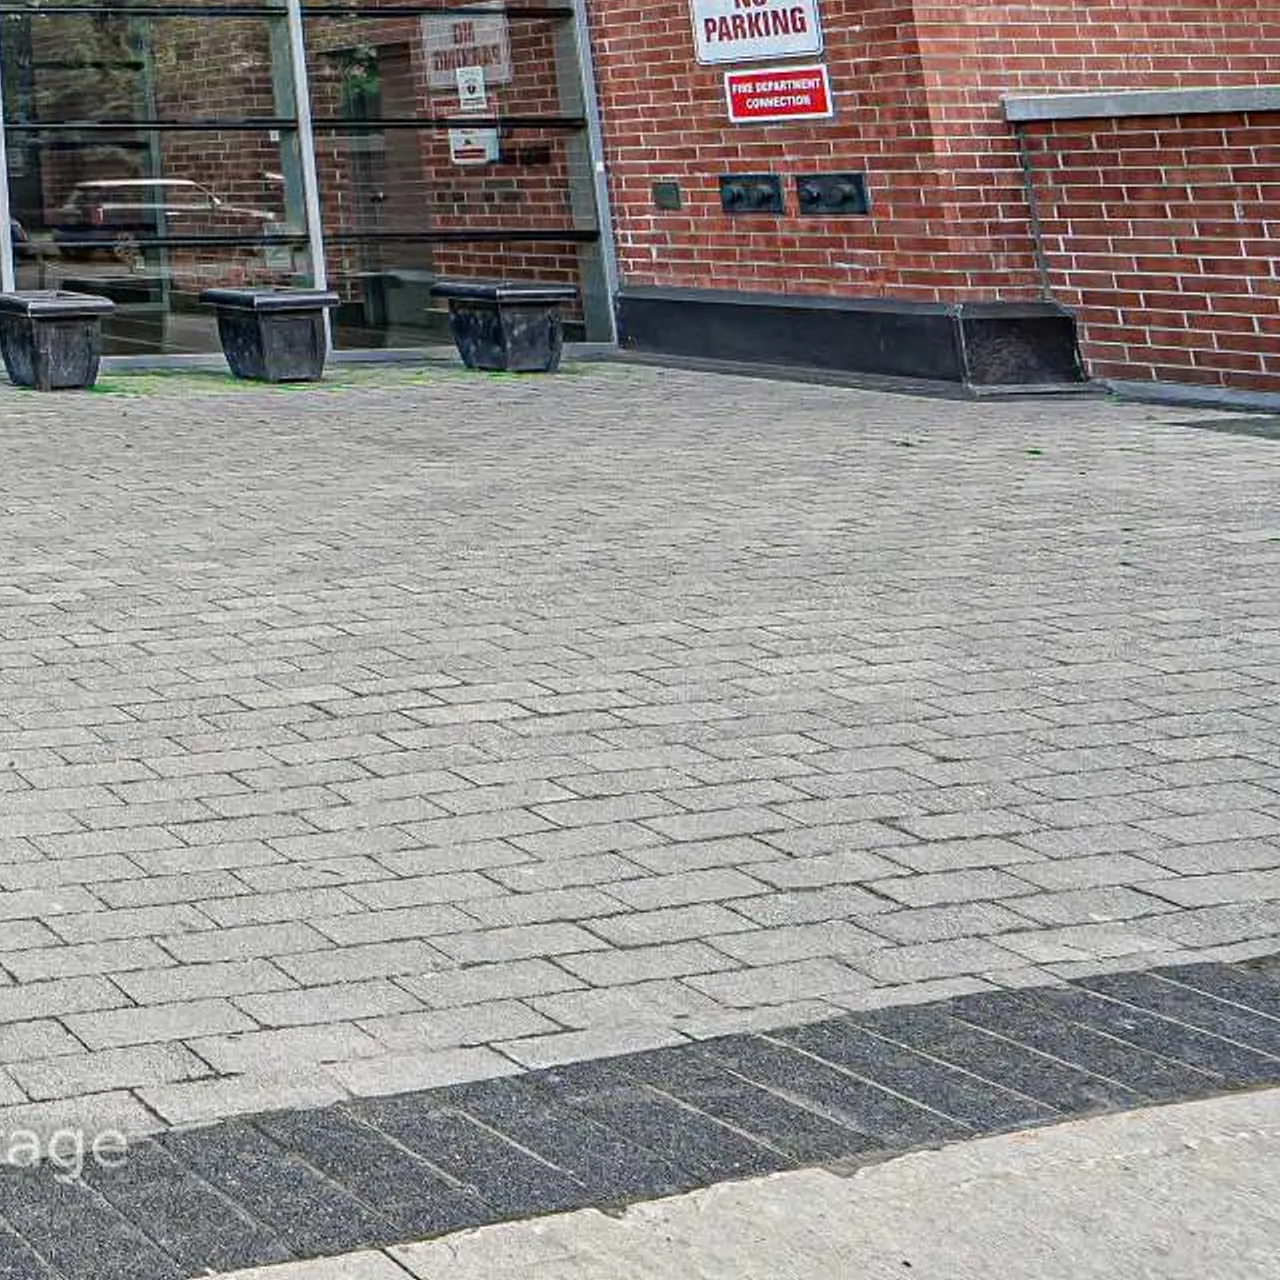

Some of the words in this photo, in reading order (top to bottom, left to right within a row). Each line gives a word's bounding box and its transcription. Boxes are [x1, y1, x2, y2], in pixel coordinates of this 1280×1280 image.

[704, 7, 807, 43] PARKING
[756, 78, 821, 93] DEPARTMENT
[746, 96, 812, 110] CONNECTION
